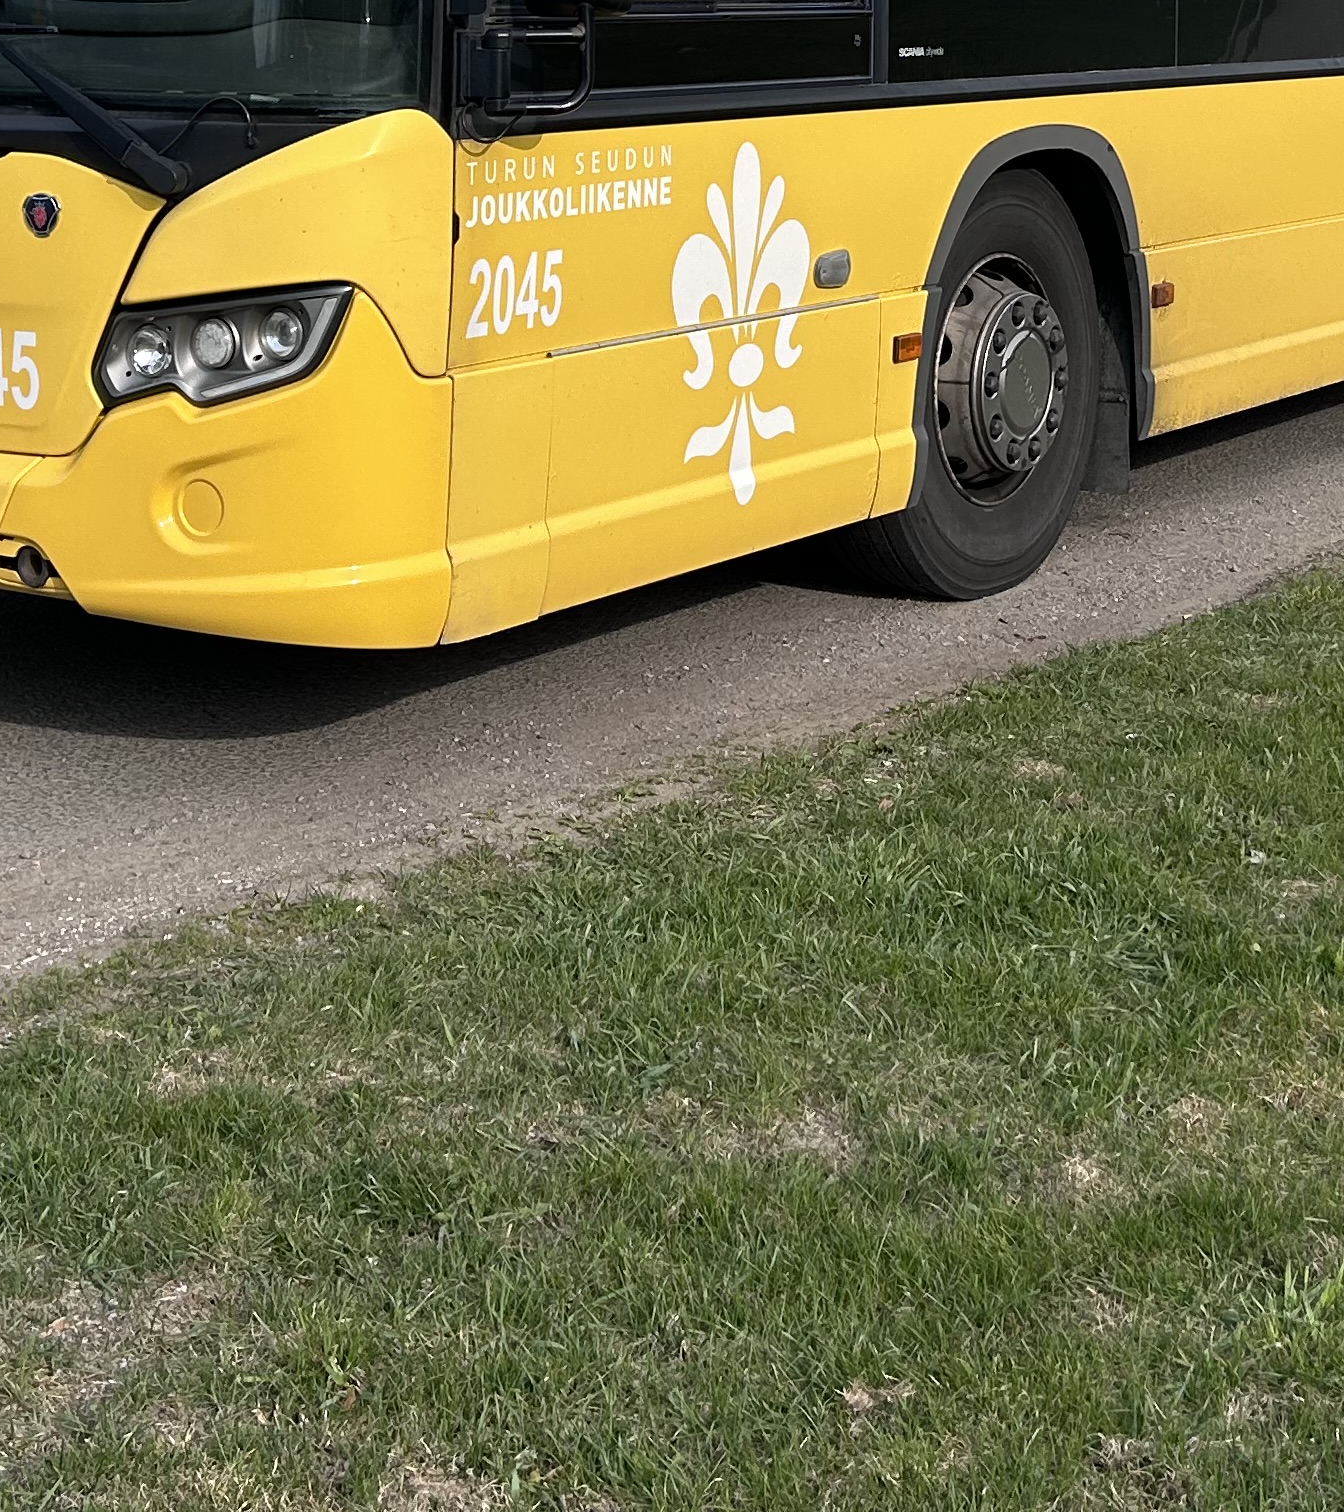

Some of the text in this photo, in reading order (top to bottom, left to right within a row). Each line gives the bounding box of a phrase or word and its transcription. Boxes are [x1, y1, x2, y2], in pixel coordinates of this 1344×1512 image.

[466, 145, 673, 186] TURUN SEUDUN
[465, 176, 673, 228] JOUKKOLIIKENNE
[465, 249, 564, 340] 2045
